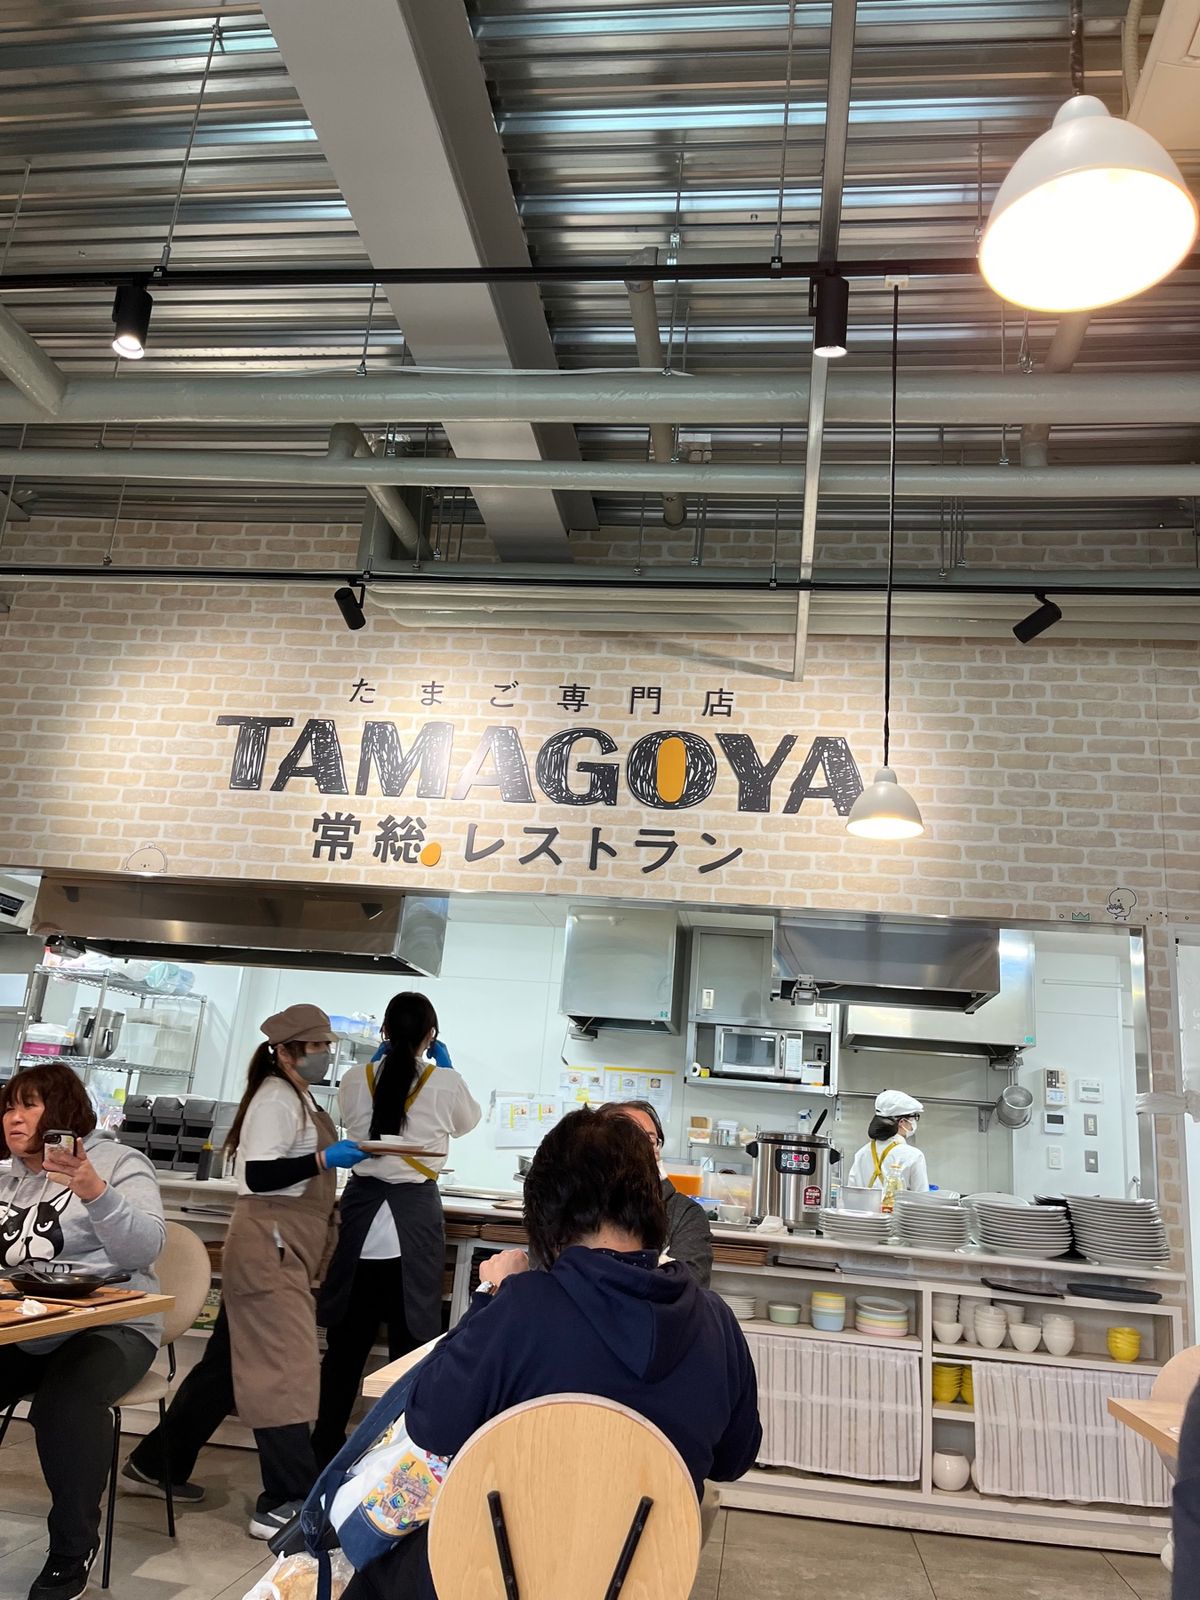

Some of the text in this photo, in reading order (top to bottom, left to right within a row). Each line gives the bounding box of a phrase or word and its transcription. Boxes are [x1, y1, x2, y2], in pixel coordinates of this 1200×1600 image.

[349, 678, 734, 717] たまご専門店
[216, 715, 864, 817] TAMAGOYA
[465, 823, 743, 874] レストラン
